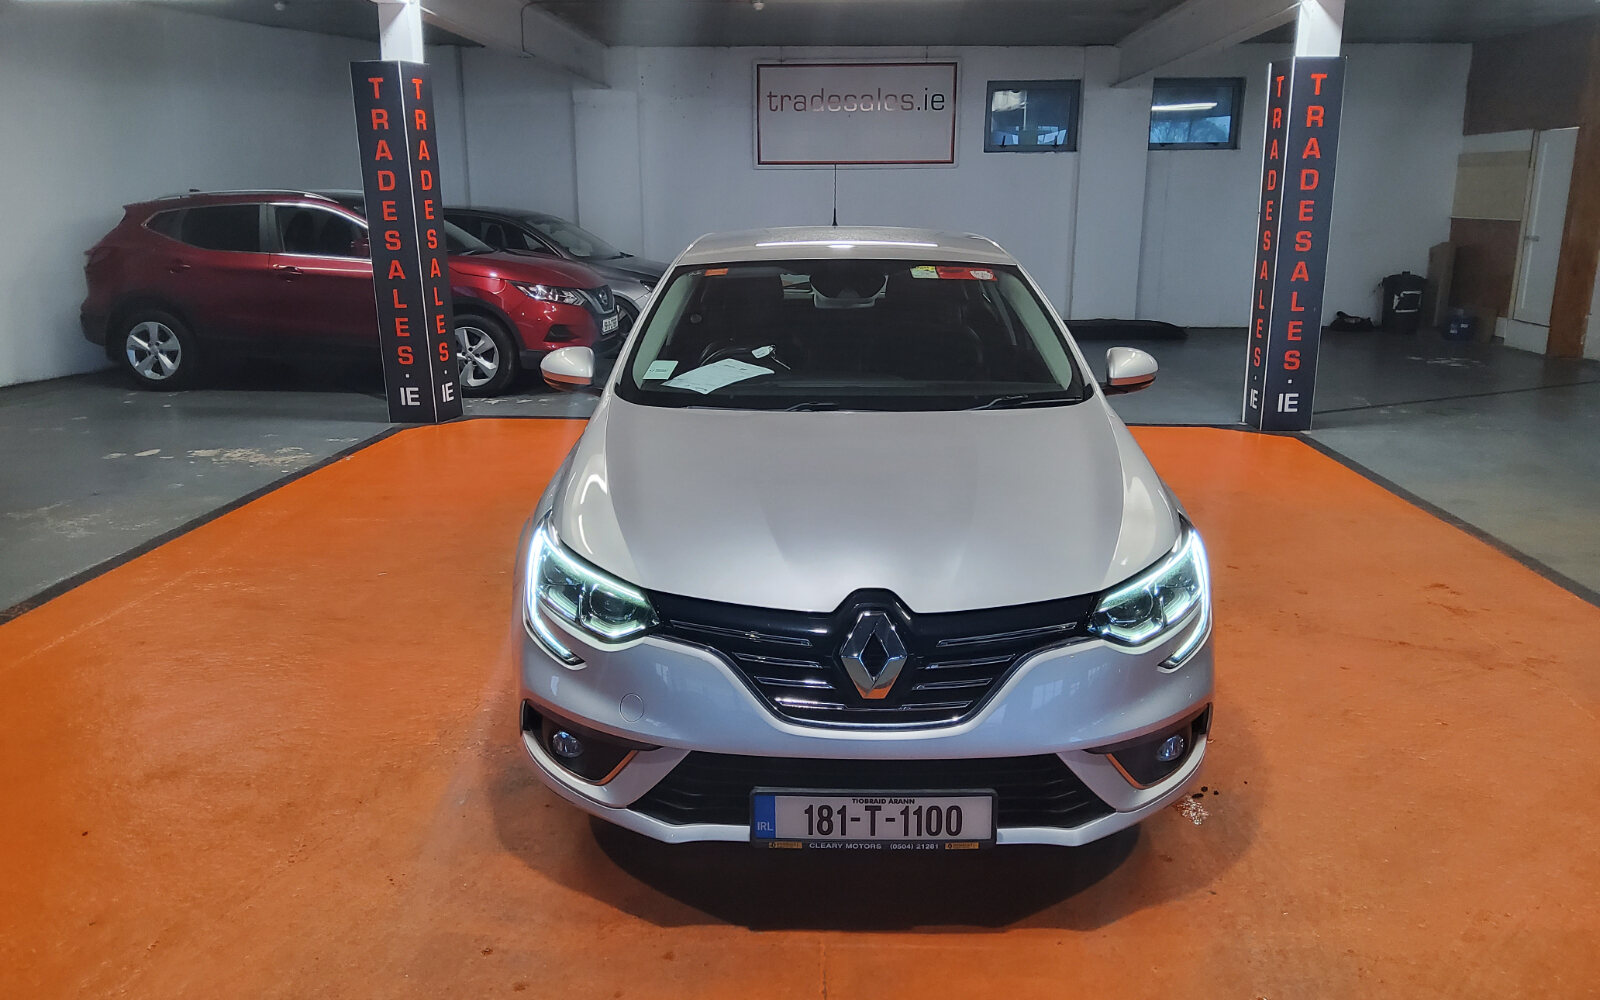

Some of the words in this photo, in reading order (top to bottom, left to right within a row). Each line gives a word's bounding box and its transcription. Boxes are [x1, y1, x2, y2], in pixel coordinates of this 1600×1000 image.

[767, 87, 945, 112] tradesales.ie
[757, 821, 774, 831] IRL
[804, 804, 963, 837] 181-T-1100
